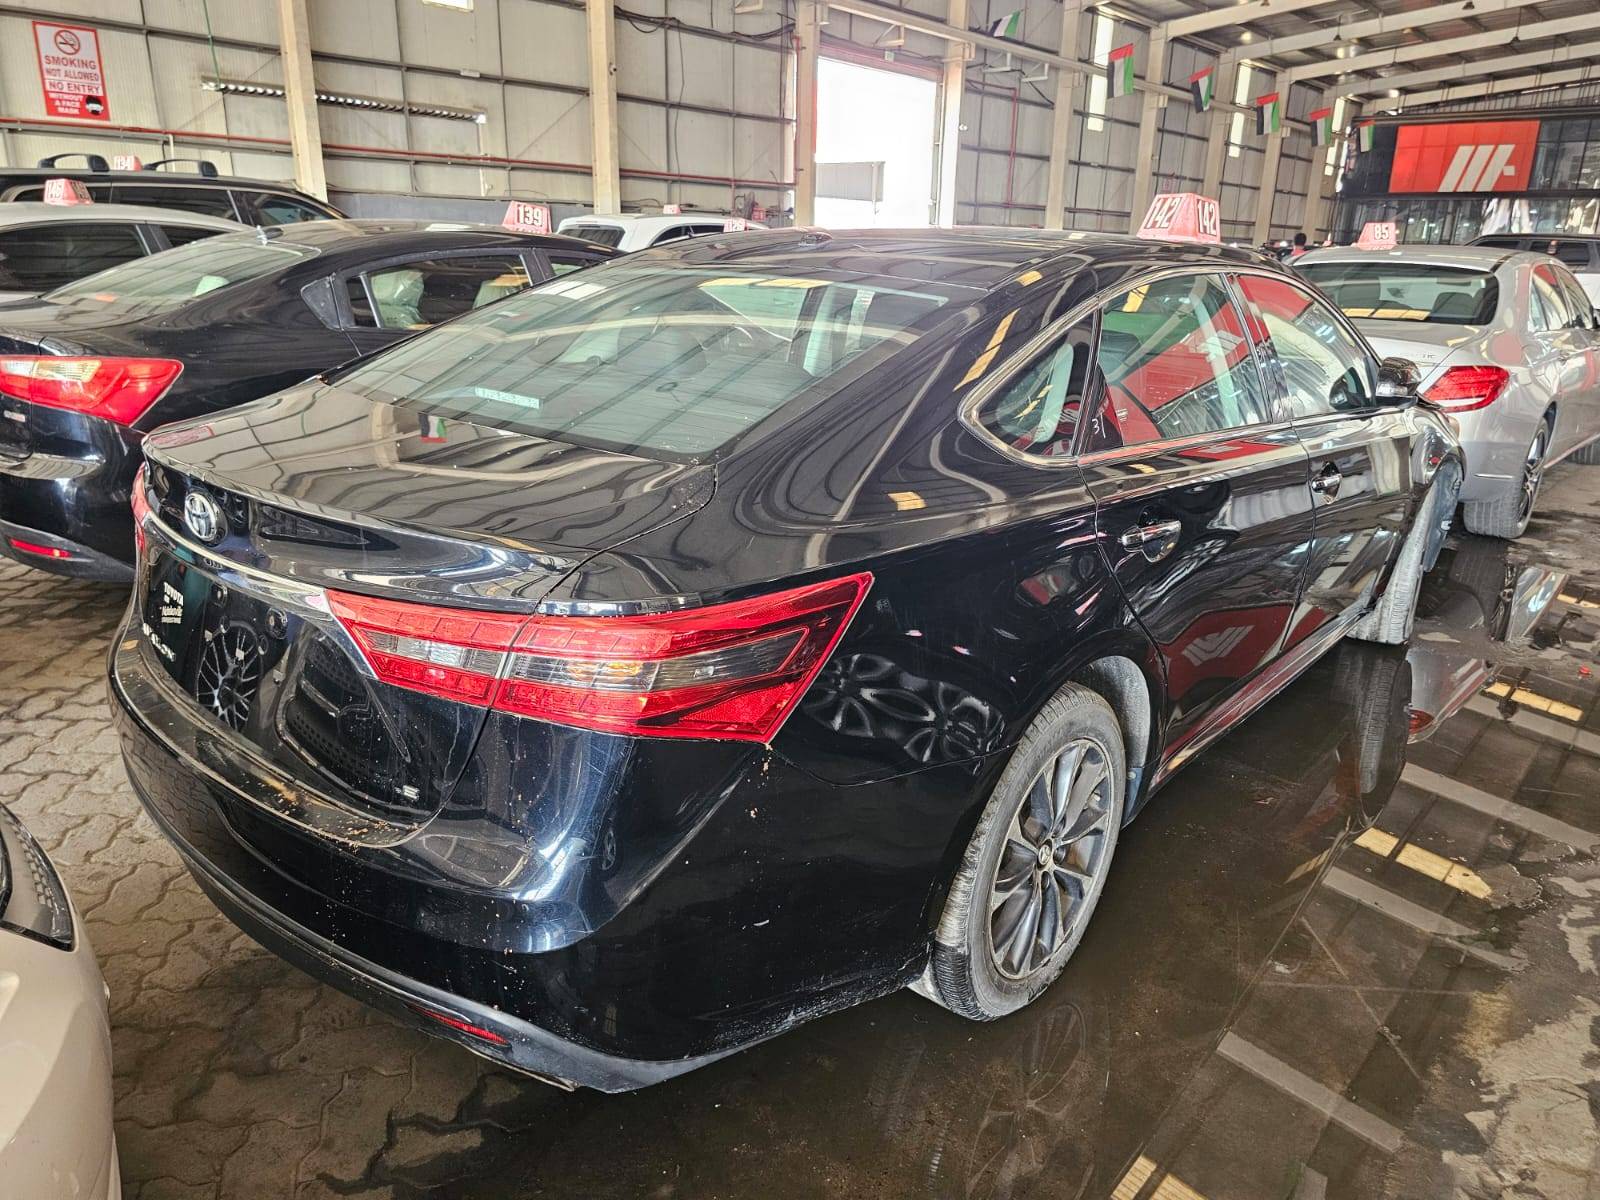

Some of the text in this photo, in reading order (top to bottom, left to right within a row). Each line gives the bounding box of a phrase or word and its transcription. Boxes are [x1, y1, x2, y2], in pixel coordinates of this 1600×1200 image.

[44, 55, 96, 70] SMOKING
[46, 68, 99, 81] NOT ALLOWED
[49, 81, 100, 94] NO ENTRY
[517, 204, 543, 227] 139
[1144, 197, 1182, 229] 142
[1197, 199, 1217, 236] 142
[1374, 224, 1390, 240] 85
